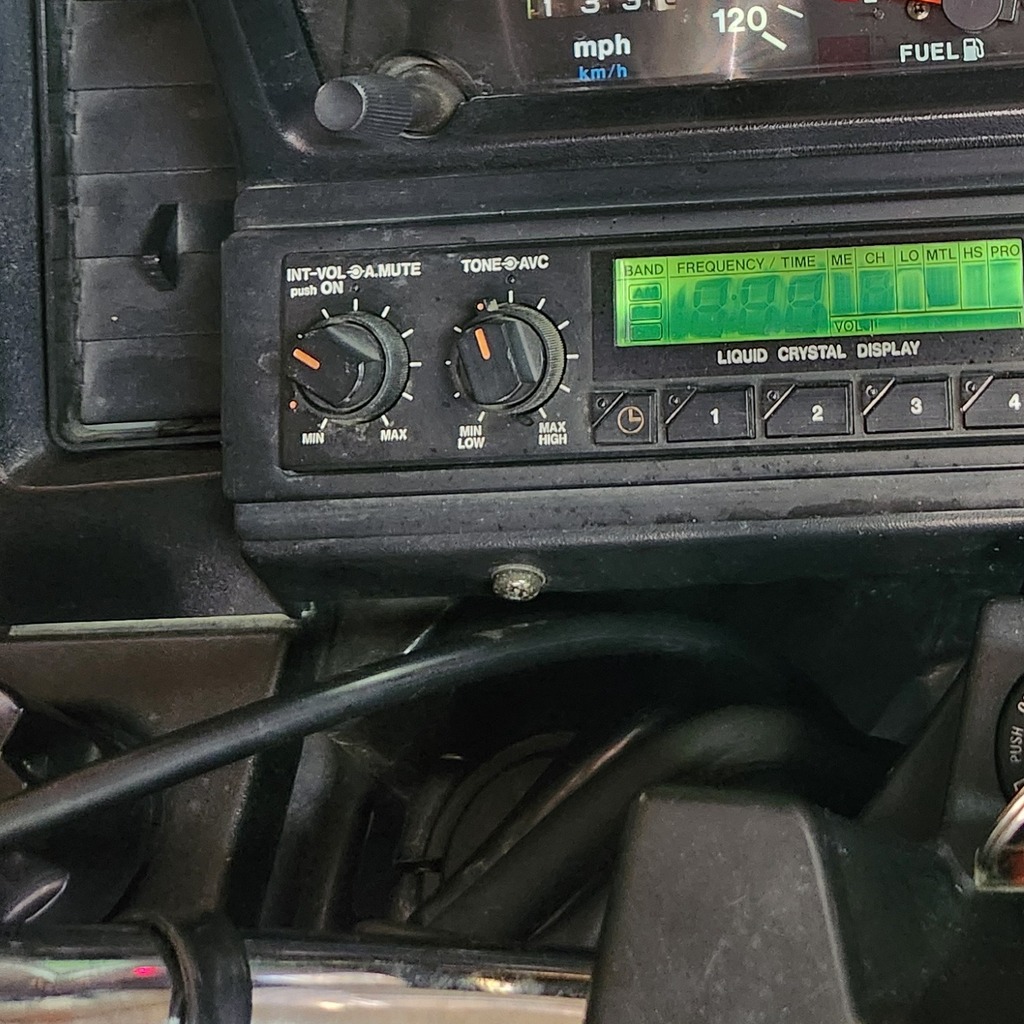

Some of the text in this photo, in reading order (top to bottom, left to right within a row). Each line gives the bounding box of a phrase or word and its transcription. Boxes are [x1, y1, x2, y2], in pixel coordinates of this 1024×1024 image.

[712, 6, 767, 32] 120
[573, 33, 631, 61] mph
[900, 42, 960, 63] FUEL
[579, 64, 628, 81] km/h
[865, 251, 886, 264] CH
[900, 249, 919, 262] LO
[926, 248, 957, 261] MTL
[963, 246, 983, 259] HS
[990, 244, 1020, 257] PRO
[460, 254, 549, 273] TONE AVC
[677, 257, 765, 274] FREQUENCY
[781, 255, 816, 268] TIME
[831, 253, 853, 266] ME
[624, 264, 664, 276] BAND
[290, 280, 344, 299] push ON
[833, 319, 863, 333] VOL
[717, 341, 921, 365] LIQUID CRYSTAL DISPLAY
[910, 397, 923, 415] 3
[1008, 394, 1021, 411] 4
[710, 408, 719, 425] 1
[812, 405, 824, 422] 2
[459, 425, 482, 437] MIN
[539, 421, 566, 434] MAX
[302, 432, 325, 445] MIN
[380, 428, 407, 443] MAX
[457, 436, 485, 450] LOW
[538, 433, 568, 446] HIGH
[1009, 726, 1024, 764] PUSH
